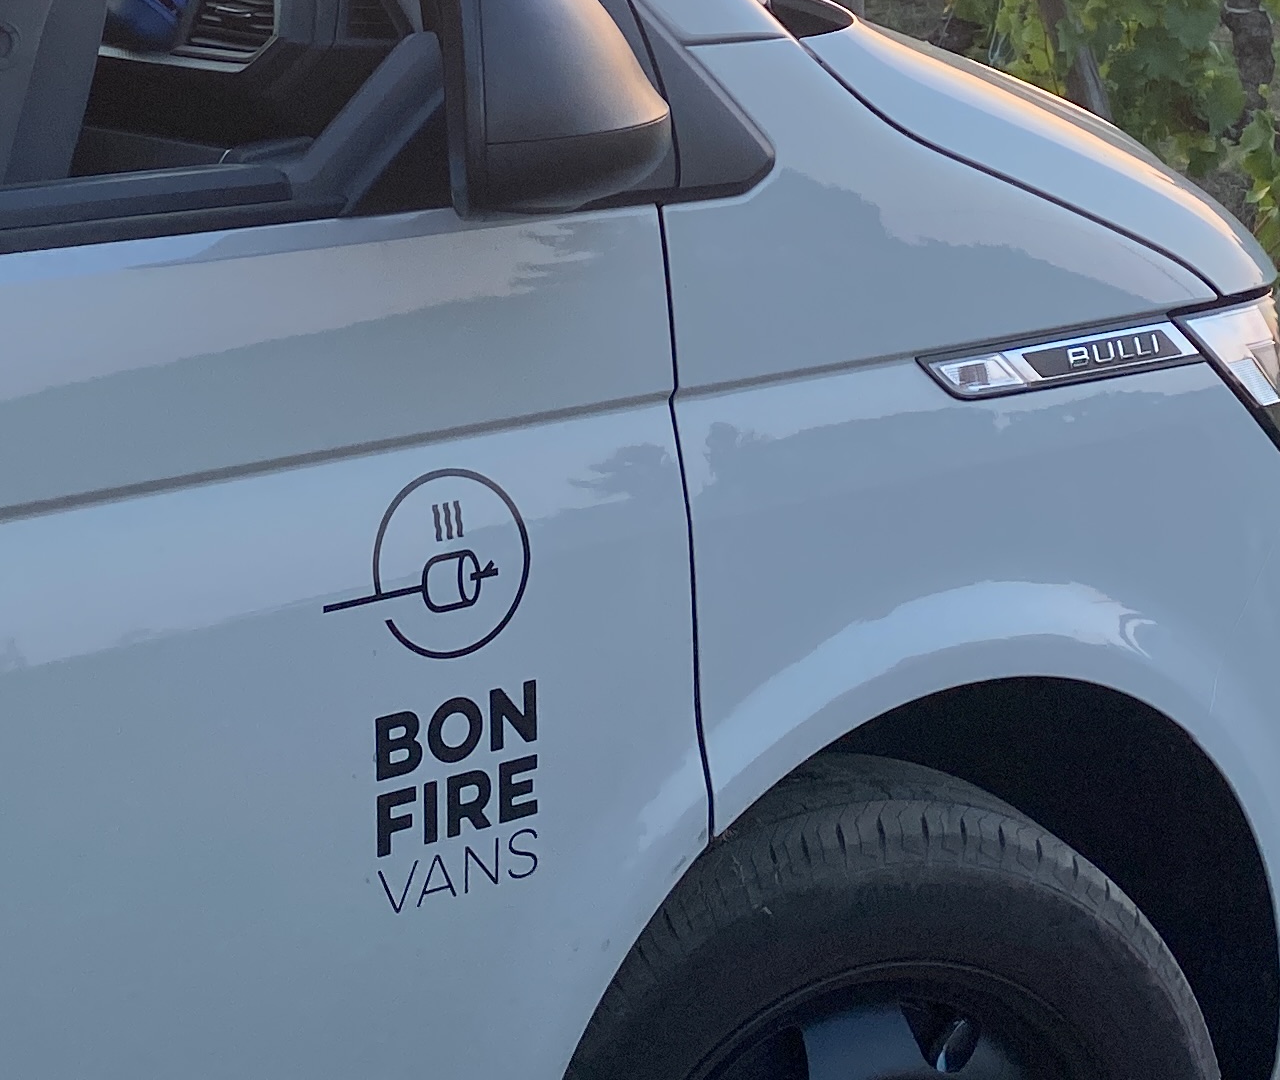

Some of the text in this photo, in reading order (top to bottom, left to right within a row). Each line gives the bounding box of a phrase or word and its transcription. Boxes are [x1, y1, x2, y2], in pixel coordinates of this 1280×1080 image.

[1067, 333, 1159, 368] BULLI
[375, 679, 537, 781] BON
[376, 754, 538, 857] FIRE
[378, 828, 538, 913] VANS
